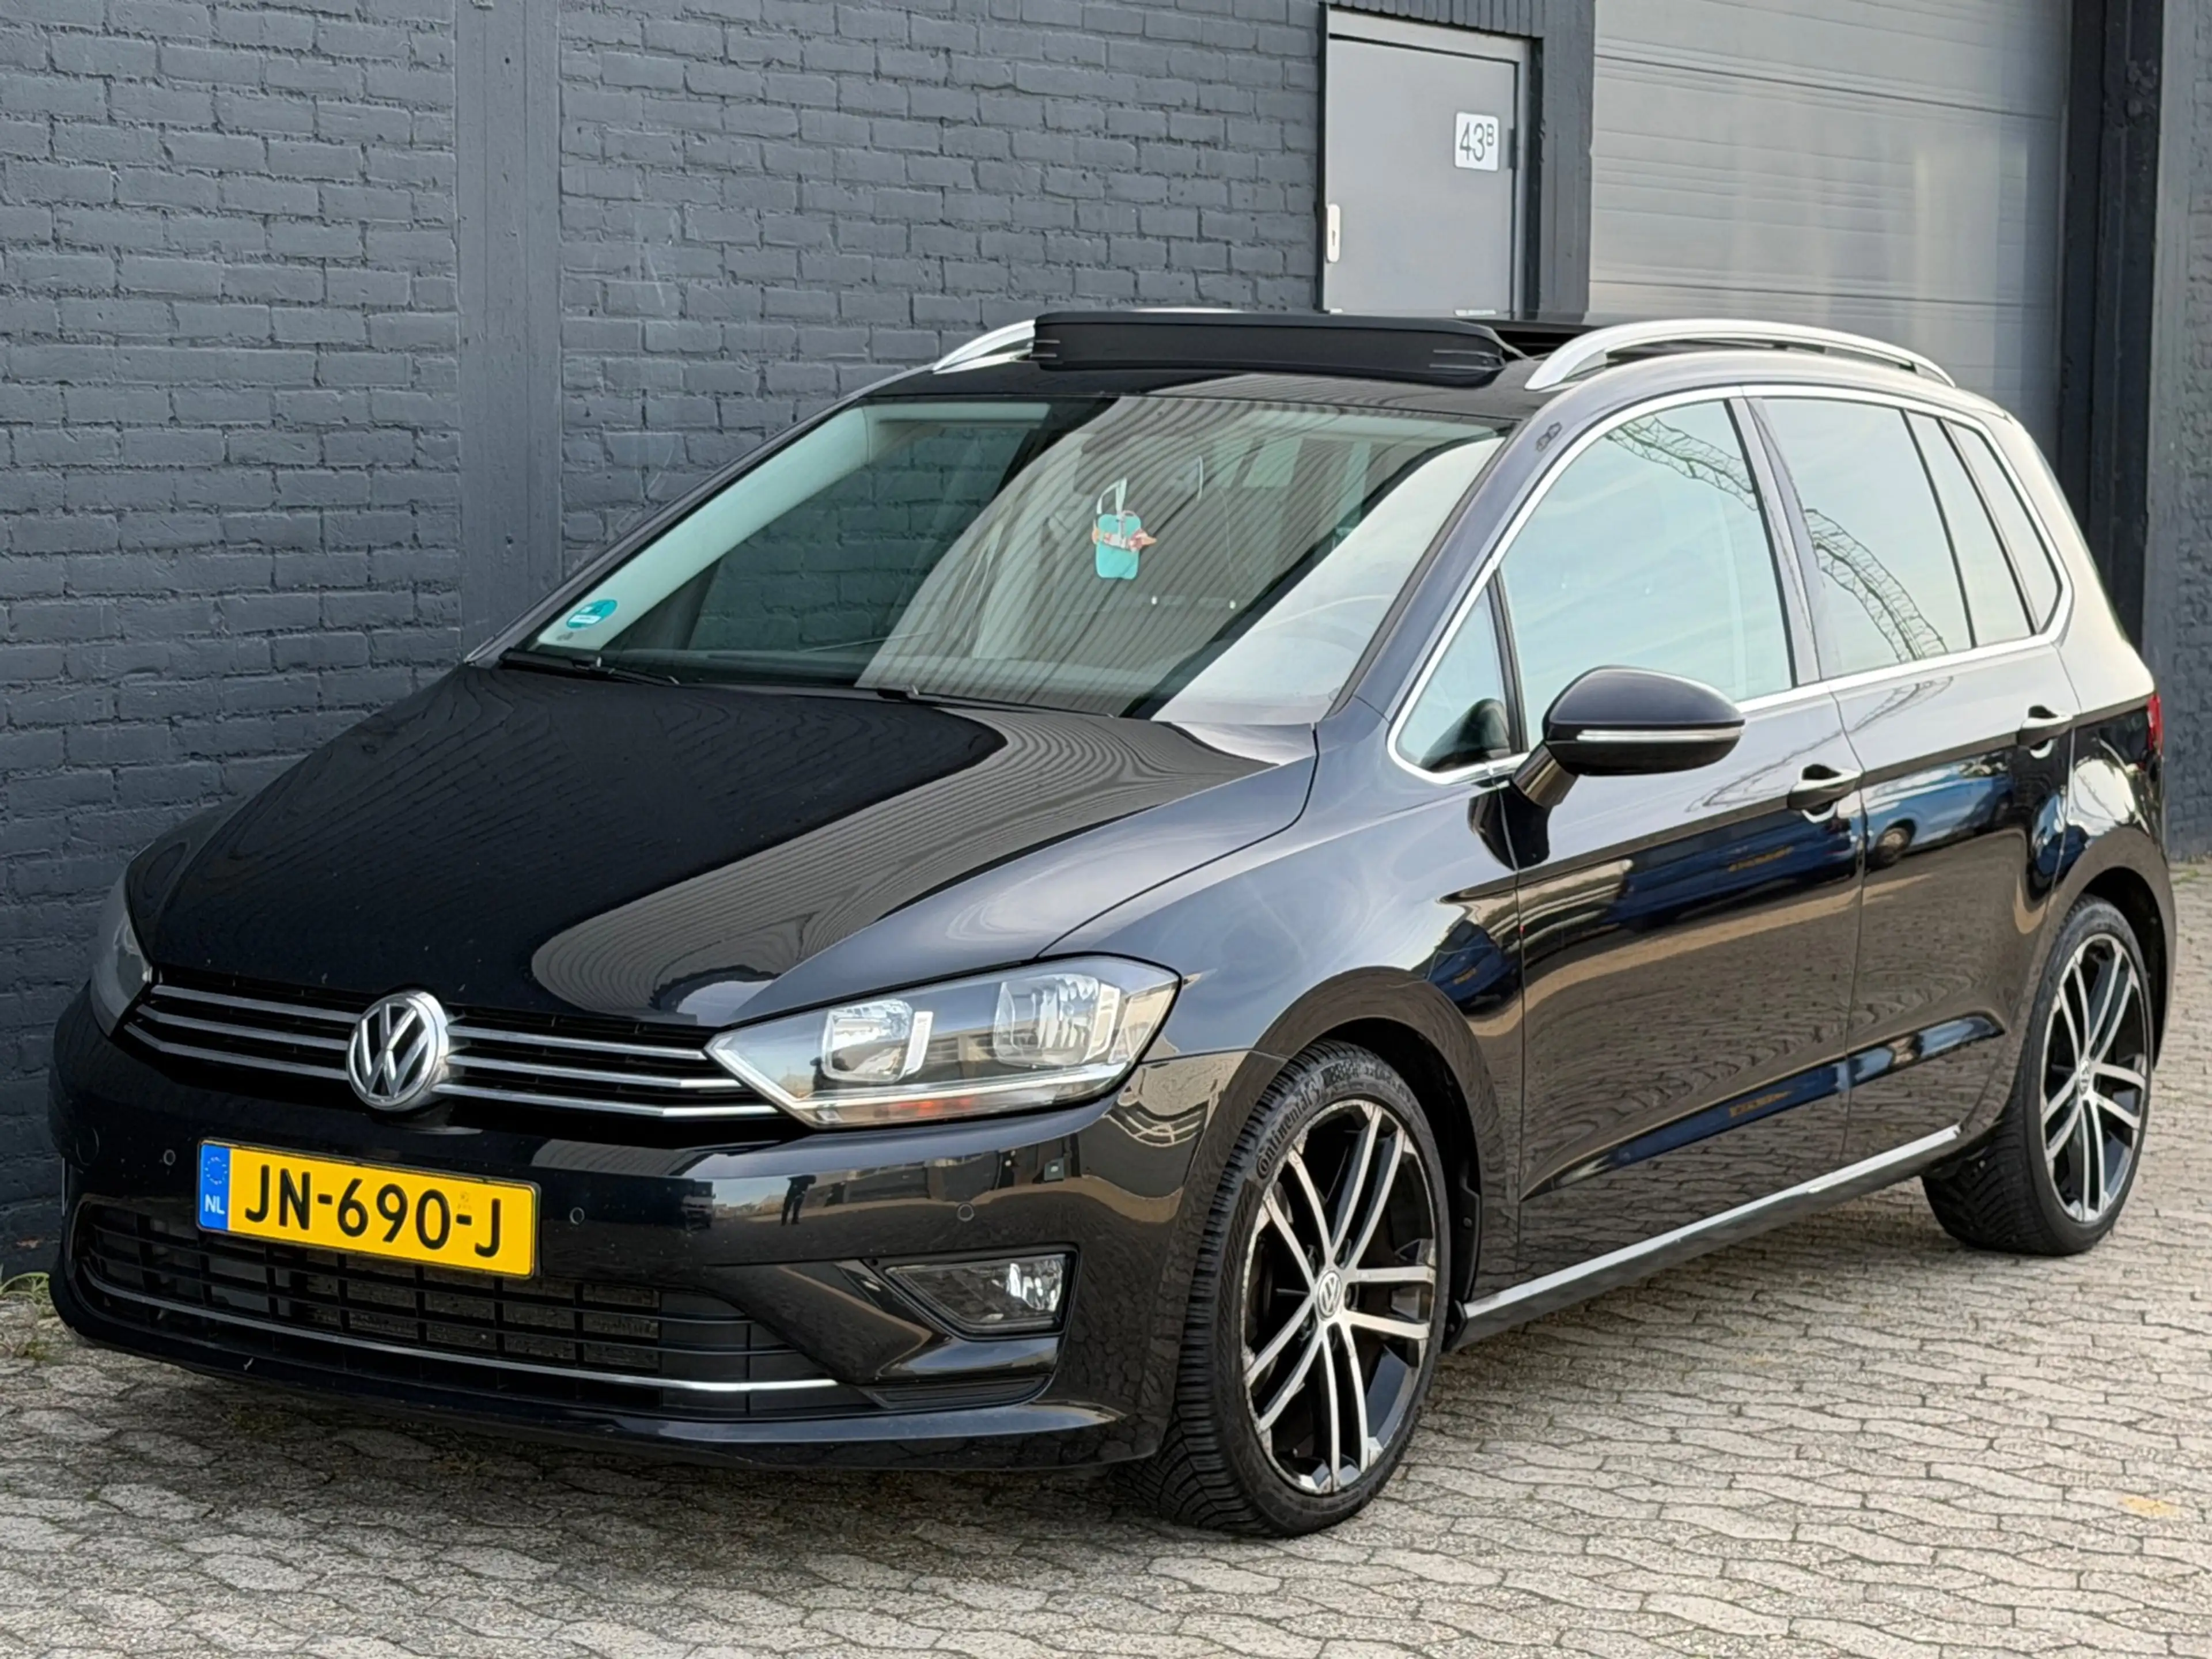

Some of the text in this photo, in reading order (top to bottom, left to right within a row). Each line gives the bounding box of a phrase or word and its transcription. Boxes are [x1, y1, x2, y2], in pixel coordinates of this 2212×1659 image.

[1256, 1092, 1314, 1179] Continental
[204, 1194, 225, 1214] NL
[245, 1164, 501, 1258] JN-690-J
